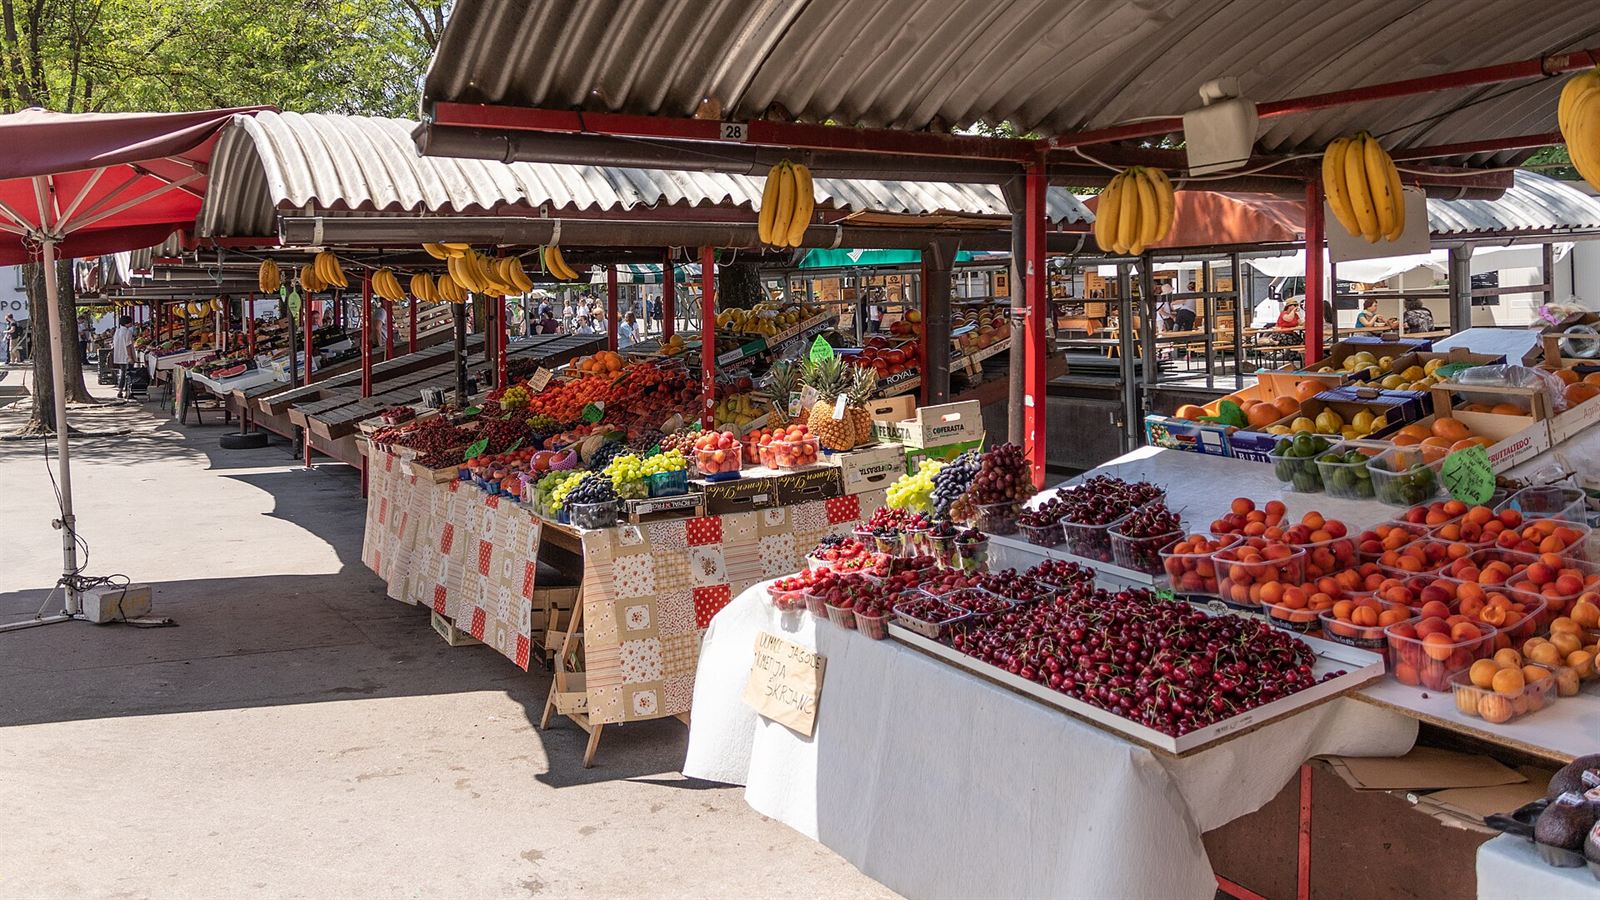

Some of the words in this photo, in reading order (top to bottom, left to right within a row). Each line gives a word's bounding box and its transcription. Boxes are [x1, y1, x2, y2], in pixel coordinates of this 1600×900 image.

[726, 125, 741, 138] 28
[886, 369, 915, 385] ROYAL
[932, 424, 964, 435] COFERASTA
[779, 475, 807, 489] Dolce
[706, 485, 736, 498] Dolce
